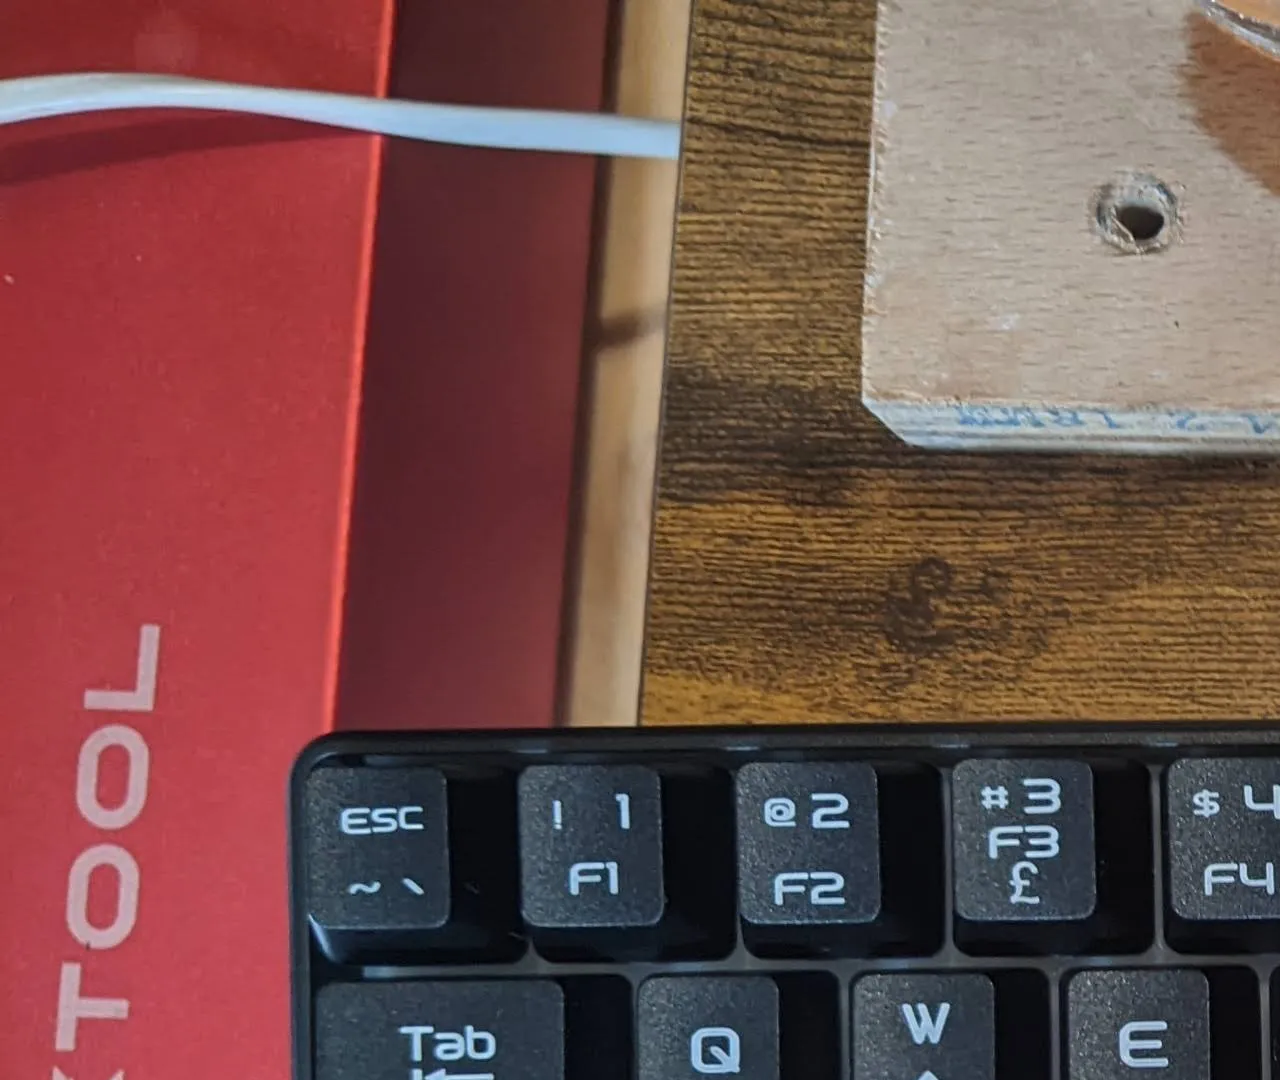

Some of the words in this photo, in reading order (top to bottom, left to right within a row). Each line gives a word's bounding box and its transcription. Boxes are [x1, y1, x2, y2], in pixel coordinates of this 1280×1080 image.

[615, 793, 630, 830] 1
[764, 797, 796, 827] @
[811, 793, 850, 829] 2
[981, 785, 1009, 810] #
[1022, 778, 1061, 814] 3
[1192, 789, 1220, 818] $
[340, 806, 424, 835] ESC
[988, 825, 1060, 859] F3
[569, 861, 619, 896] F1
[773, 871, 846, 906] F2
[1009, 861, 1040, 904] £
[1203, 862, 1275, 896] F4
[901, 1002, 951, 1045] W
[399, 1025, 496, 1062] Tab
[690, 1027, 741, 1074] Q
[1118, 1020, 1169, 1068] E
